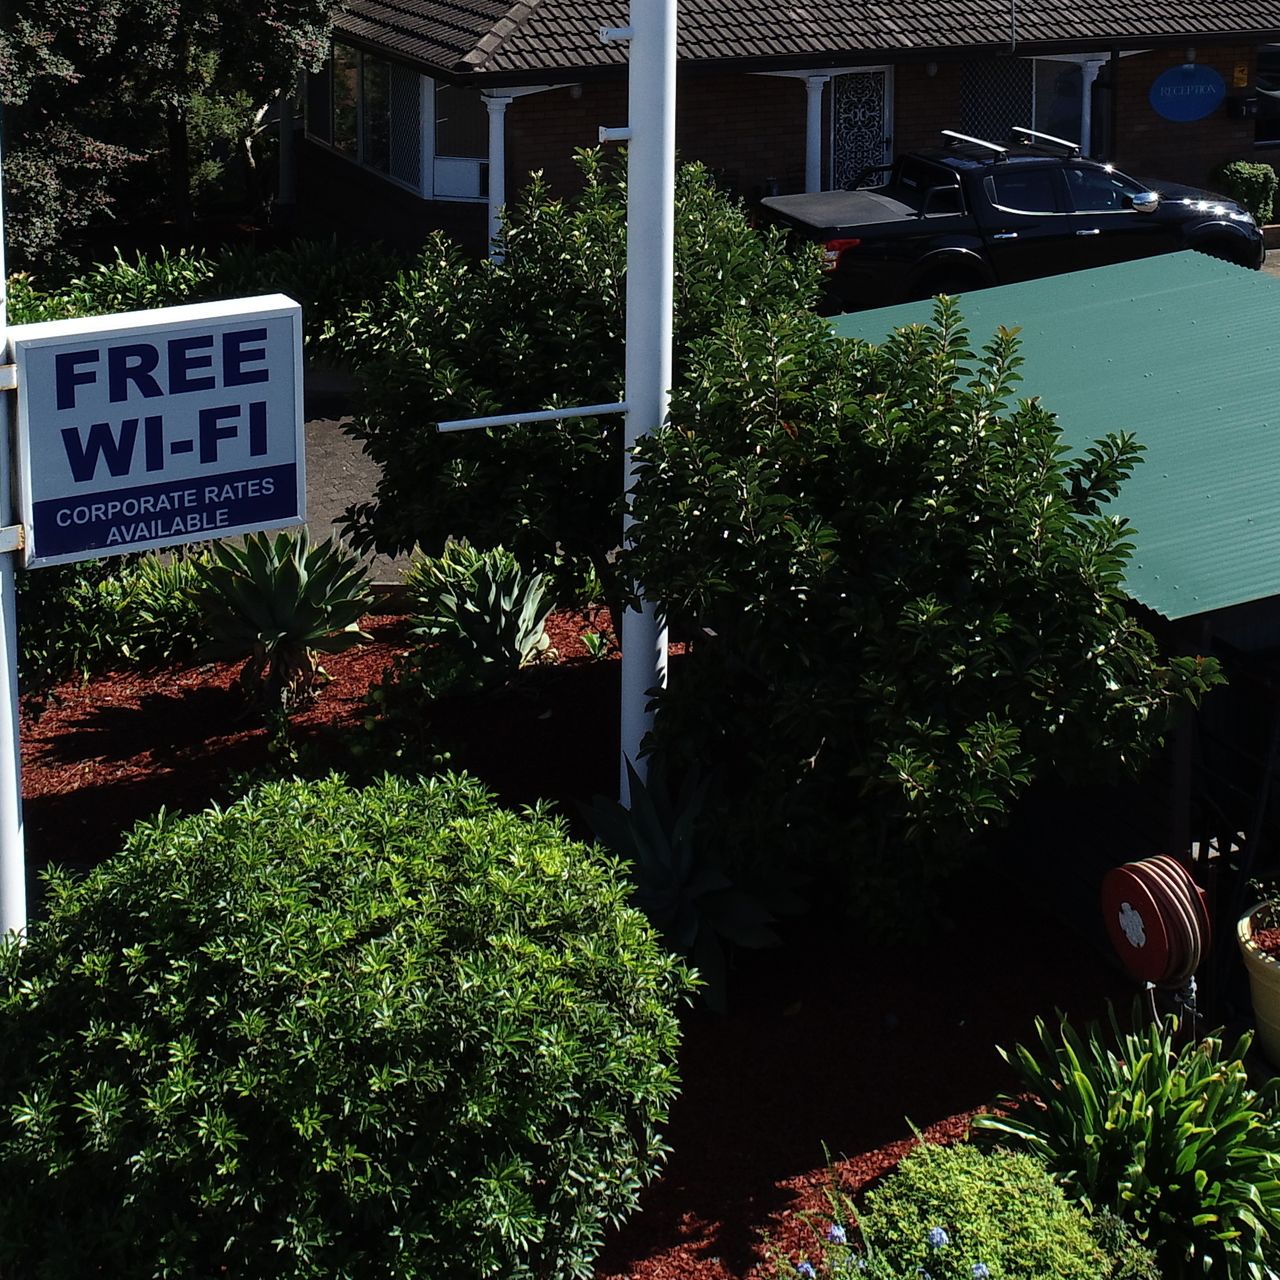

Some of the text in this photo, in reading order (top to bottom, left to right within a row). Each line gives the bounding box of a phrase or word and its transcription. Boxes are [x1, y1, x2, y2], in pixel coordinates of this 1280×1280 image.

[1160, 84, 1216, 97] RECEPTION
[55, 328, 269, 410] FREE
[61, 401, 267, 483] WI-FI
[56, 478, 275, 527] CORPORATE RATES
[107, 508, 230, 545] AVAILABLE
